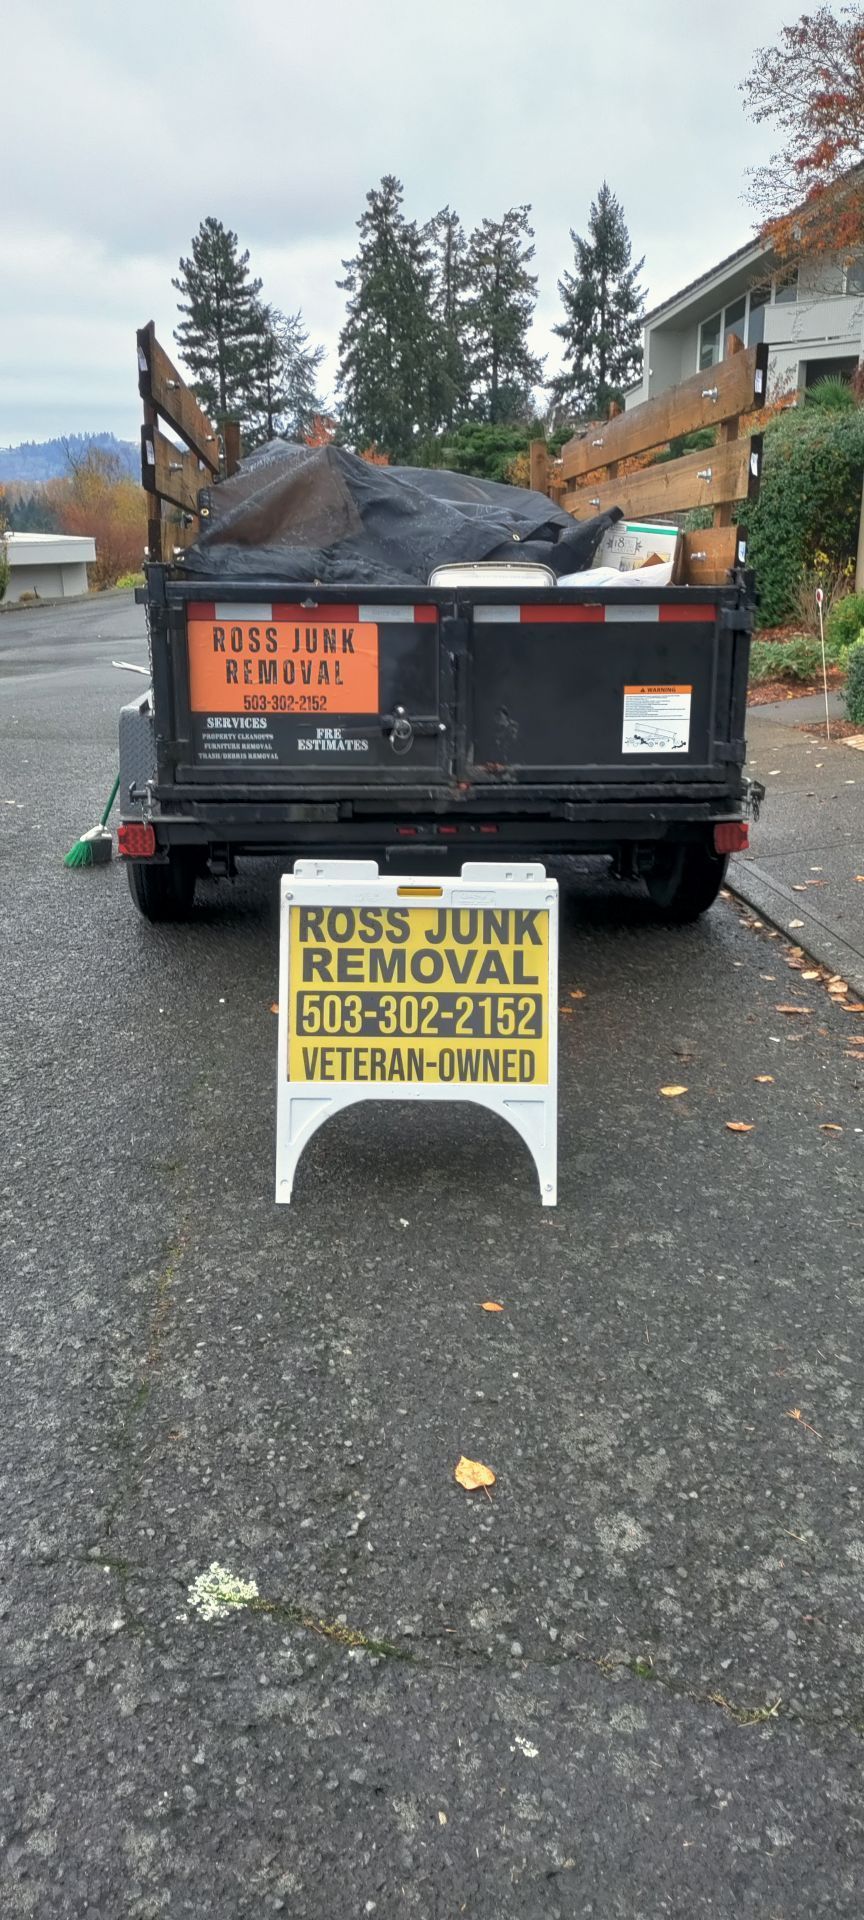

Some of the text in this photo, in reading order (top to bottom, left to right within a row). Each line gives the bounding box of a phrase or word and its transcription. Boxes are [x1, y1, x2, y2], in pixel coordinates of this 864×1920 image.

[213, 626, 355, 654] ROSS JUNK
[226, 659, 344, 685] REMOVAL
[243, 695, 328, 711] 503-302-2152
[206, 717, 268, 729] SERVICES
[198, 752, 279, 760] TRASH/DEBRIS REMOVAL
[297, 739, 369, 751] ESTIMATES
[299, 907, 543, 945] ROSS JUNK
[302, 947, 539, 985] REMOVAL
[302, 994, 536, 1036] 503-302-2152
[302, 1046, 536, 1083] VETERAN-OWNED
